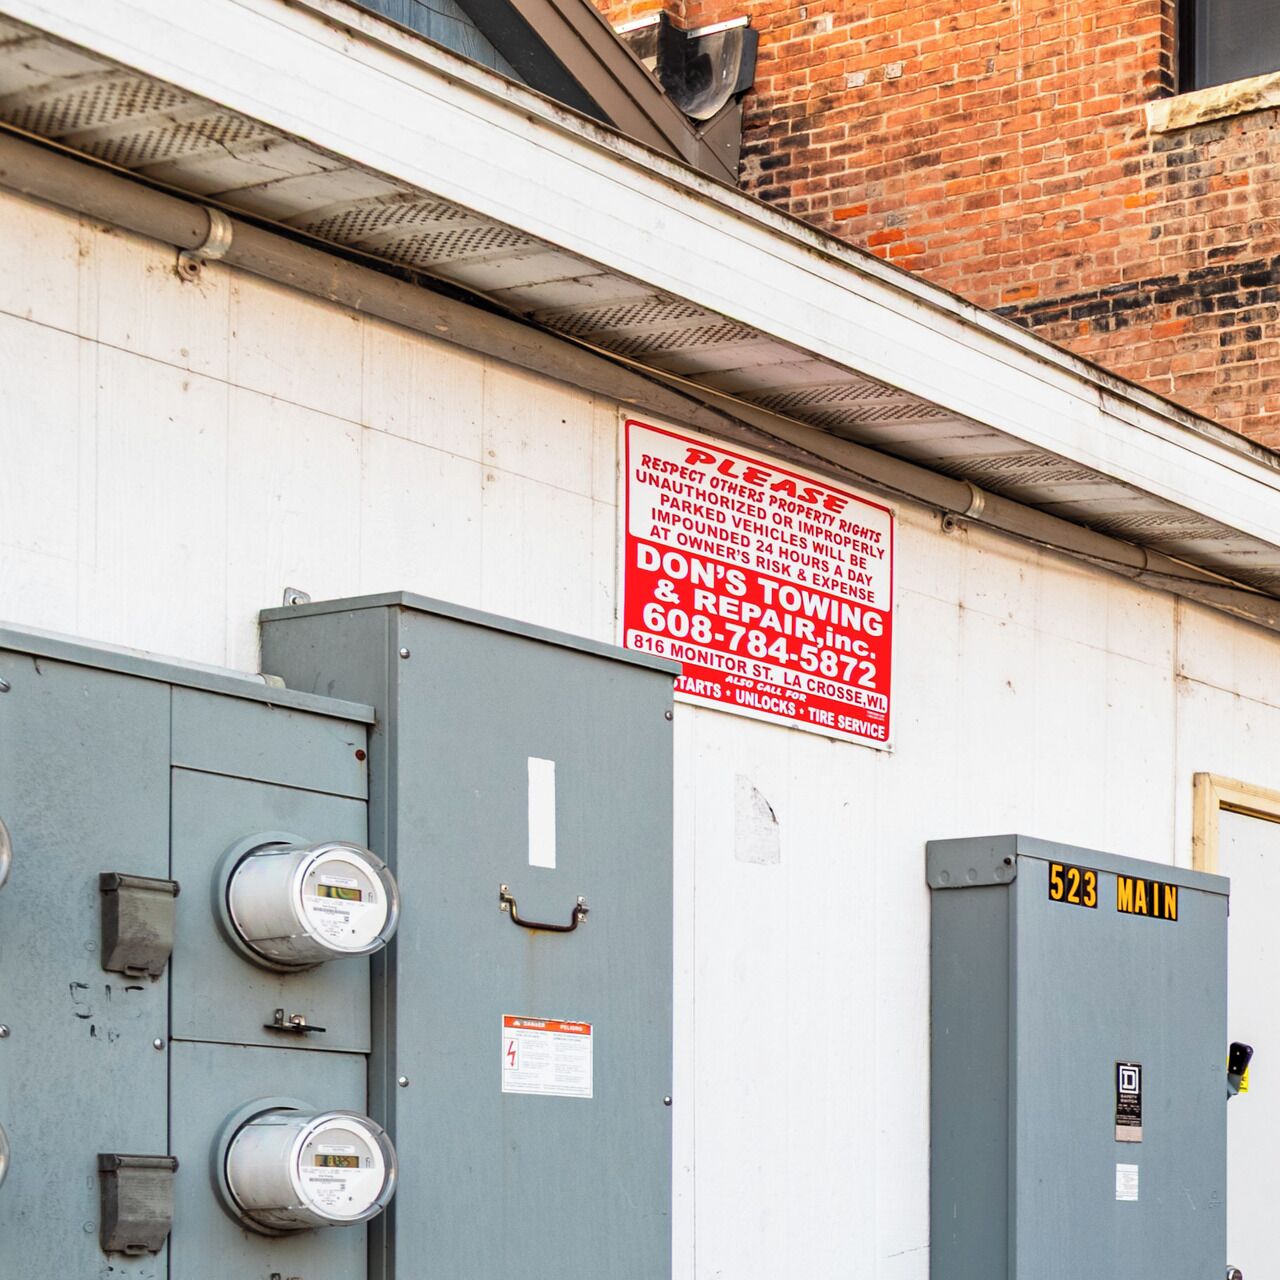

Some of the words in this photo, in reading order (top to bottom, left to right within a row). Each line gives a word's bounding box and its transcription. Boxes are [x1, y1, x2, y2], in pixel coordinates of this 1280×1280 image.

[636, 469, 767, 520] UNAUTHORIZED
[772, 512, 793, 529] OR
[799, 520, 885, 560] IMPROPERLY
[641, 454, 706, 484] RESPECT
[710, 476, 765, 504] OTHERS
[769, 495, 835, 527] PROPERTY
[839, 519, 882, 544] RIGHTS
[685, 447, 848, 514] PLEASE
[650, 525, 671, 541] AT
[677, 532, 750, 564] OWNER'S
[756, 555, 791, 577] RISK
[797, 568, 807, 581] &
[812, 573, 875, 603] EXPENSE
[652, 507, 750, 547] IMPOUNDED
[756, 540, 773, 555] 24
[779, 546, 829, 573] HOURS
[834, 565, 843, 578] A
[848, 569, 872, 587] DAY
[661, 493, 726, 523] PARKED
[732, 515, 808, 550] VEHICLES
[812, 541, 845, 562] WILL
[850, 554, 867, 570] BE
[637, 542, 747, 597] DON'S
[758, 577, 884, 637] TOWING
[654, 578, 680, 605] &
[634, 634, 664, 654] 816
[671, 643, 747, 674] MONITOR
[753, 664, 773, 681] ST.
[784, 672, 801, 688] LA
[643, 602, 877, 689] 608-784-5872
[725, 675, 753, 688] ALSO
[757, 681, 782, 696] CALL
[785, 690, 807, 702] FOR
[735, 688, 796, 716] UNLOCKS
[808, 707, 835, 726] TIRE
[837, 716, 885, 739] SERVICE
[1050, 863, 1097, 907] 523
[1117, 876, 1177, 920] MAIN
